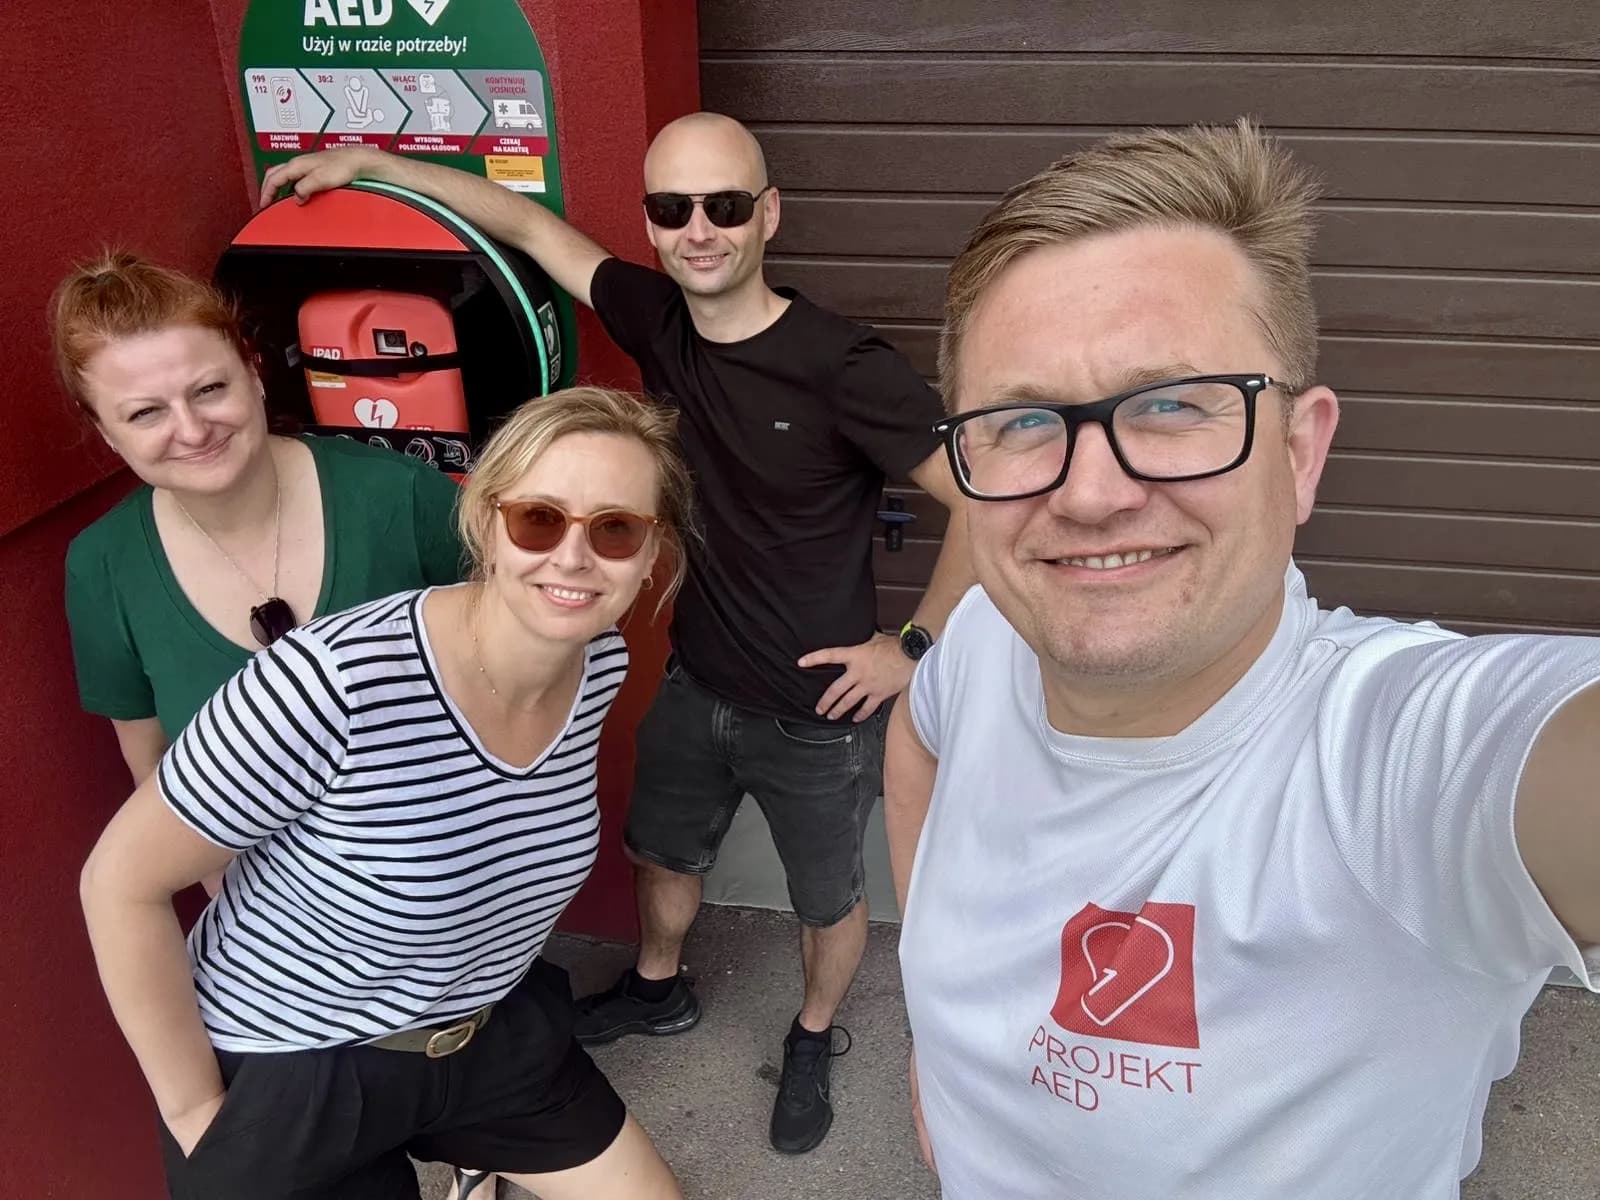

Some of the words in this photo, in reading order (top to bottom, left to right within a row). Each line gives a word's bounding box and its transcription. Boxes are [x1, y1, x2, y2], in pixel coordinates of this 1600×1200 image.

[303, 0, 393, 26] AED
[302, 35, 334, 56] Użyj
[338, 40, 352, 51] w
[355, 36, 392, 51] razie
[396, 36, 467, 56] potrzeby!
[252, 74, 266, 83] 999
[317, 74, 334, 83] 30:2
[254, 85, 268, 94] 112
[403, 84, 417, 92] AED
[271, 142, 279, 150] PO
[280, 142, 301, 150] POMOC
[313, 347, 341, 360] IPAD
[1028, 1024, 1202, 1094] PROJEKT
[1031, 1065, 1099, 1111] AED
